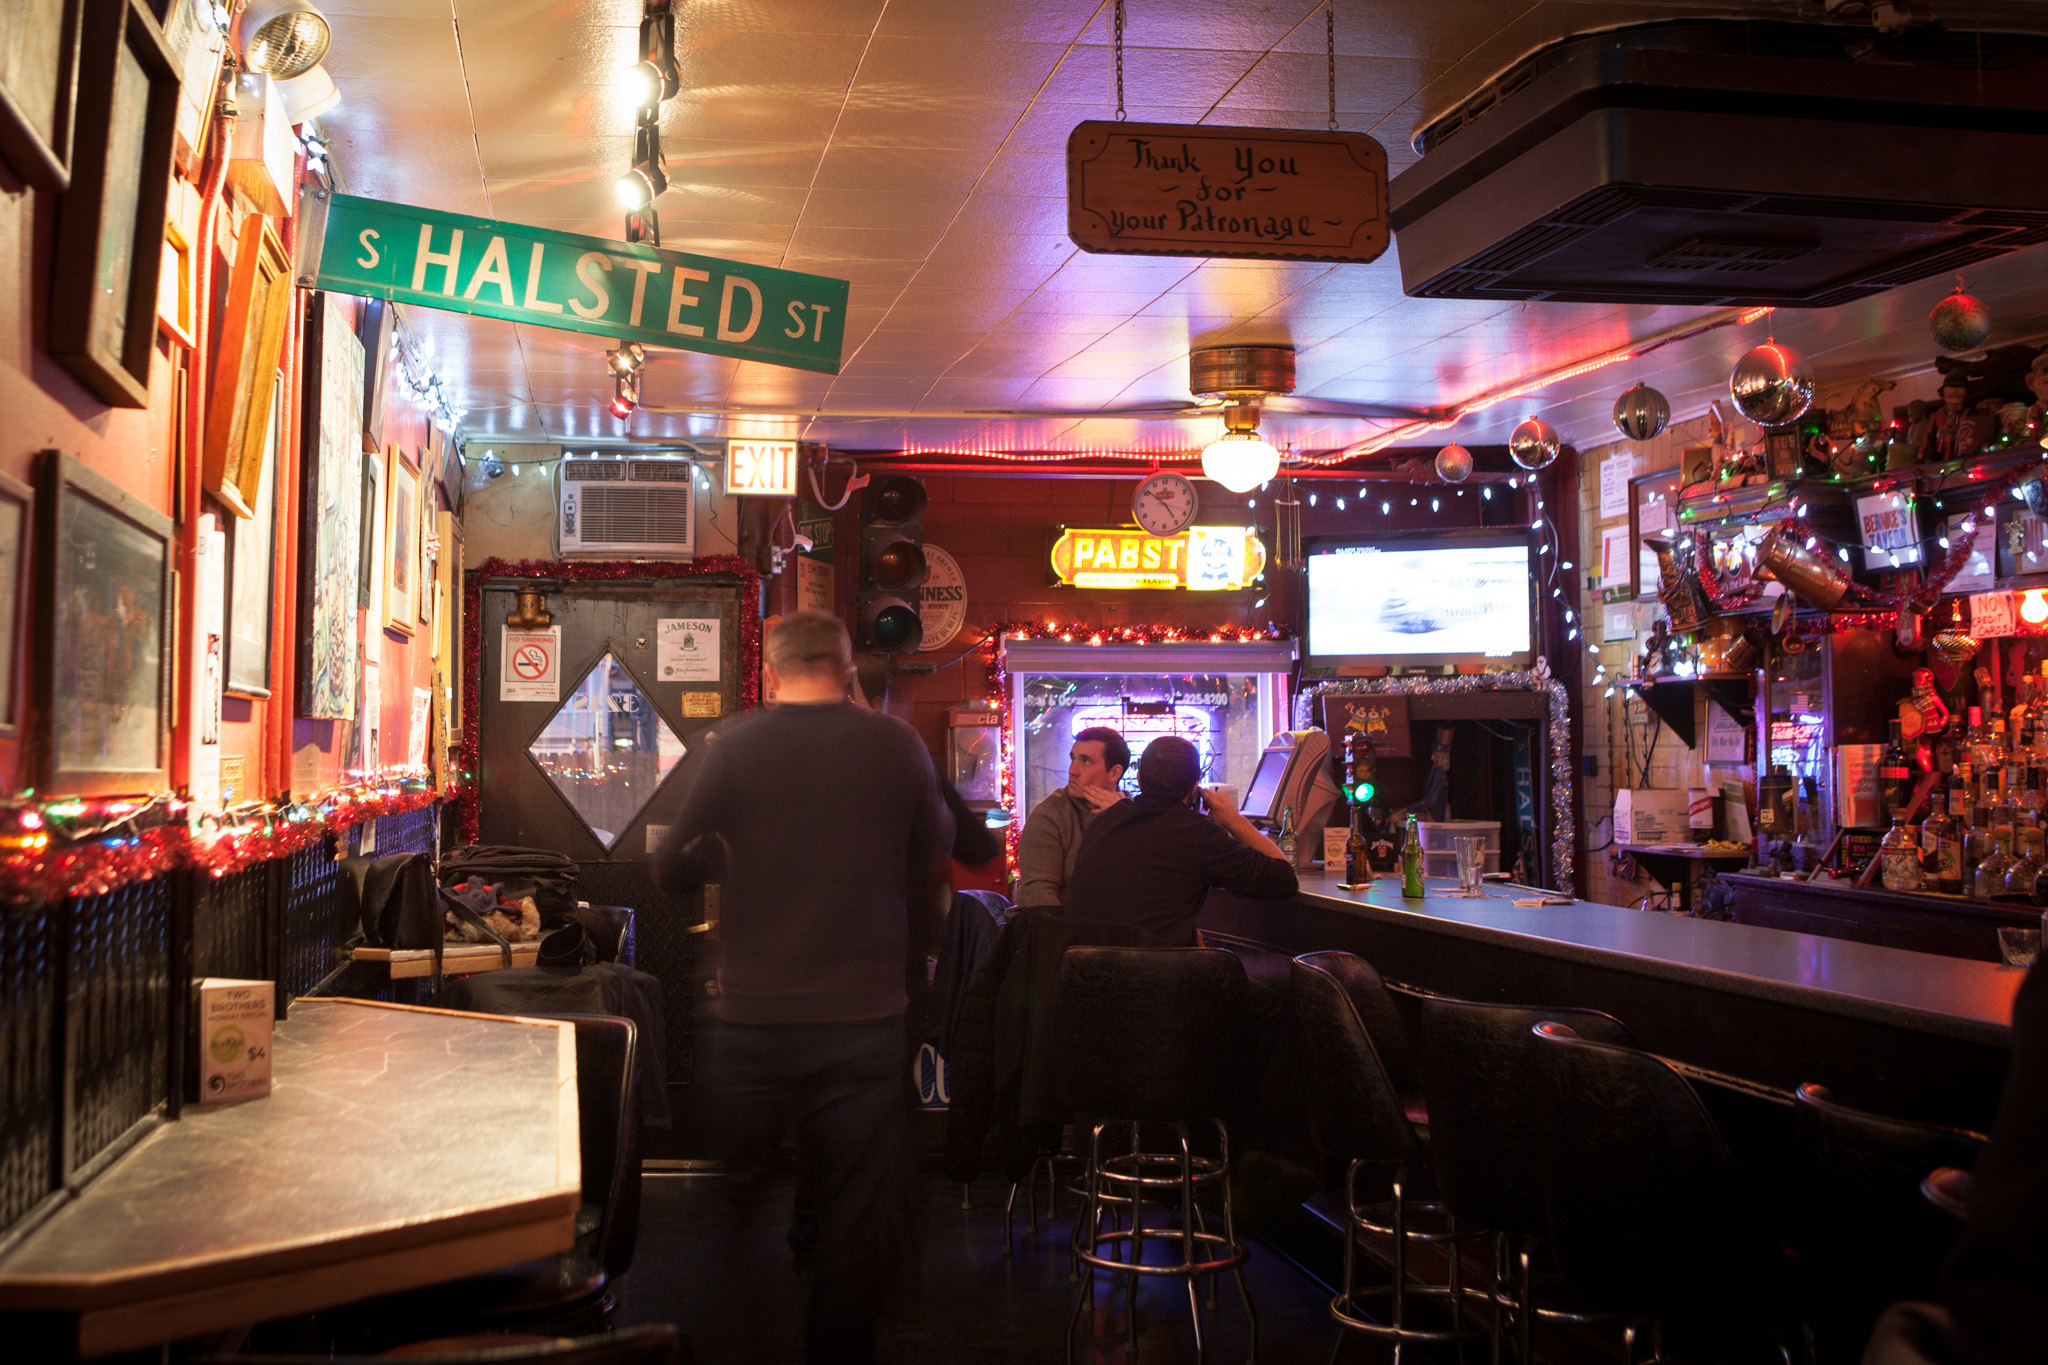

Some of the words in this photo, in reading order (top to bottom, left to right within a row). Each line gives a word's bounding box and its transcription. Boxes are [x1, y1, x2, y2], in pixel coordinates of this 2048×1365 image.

[1127, 140, 1200, 173] Thank
[1230, 147, 1299, 184] You
[1197, 175, 1247, 201] for
[1176, 200, 1316, 241] Patronage
[356, 228, 380, 269] S
[411, 223, 763, 344] HALSTED
[784, 301, 831, 343] ST
[730, 445, 794, 489] EXIT
[814, 521, 831, 545] STOP
[1863, 508, 1908, 534] BERNICE'S
[1868, 527, 1909, 551] TAVERN
[1073, 537, 1186, 570] PABST
[920, 585, 963, 601] NNESS
[664, 621, 713, 634] JAMESON
[1972, 613, 2004, 628] CREDIT
[977, 712, 999, 725] cta
[210, 1000, 266, 1014] BROTHERS
[226, 990, 251, 1000] TWO
